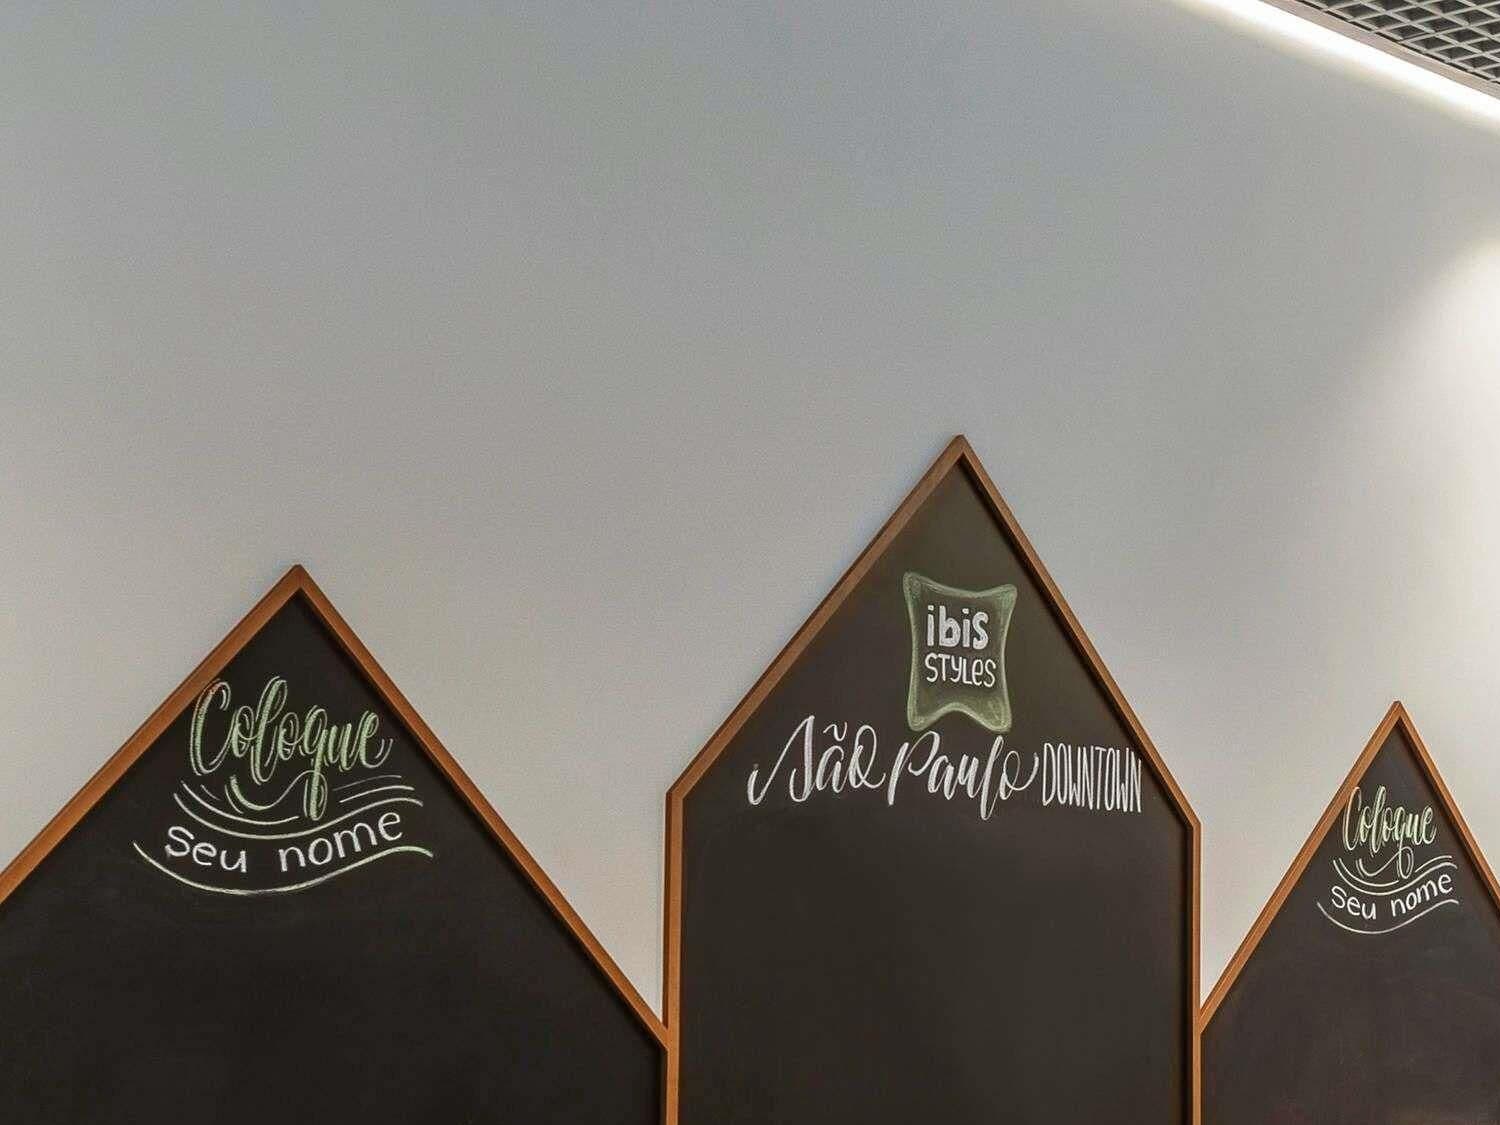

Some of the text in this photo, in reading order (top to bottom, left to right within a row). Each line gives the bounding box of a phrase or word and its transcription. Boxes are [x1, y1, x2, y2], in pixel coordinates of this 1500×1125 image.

[926, 604, 990, 651] ibis
[747, 714, 1142, 820] São Paulo DOWNTOWN
[279, 811, 403, 872] nome
[1390, 874, 1453, 917] nome
